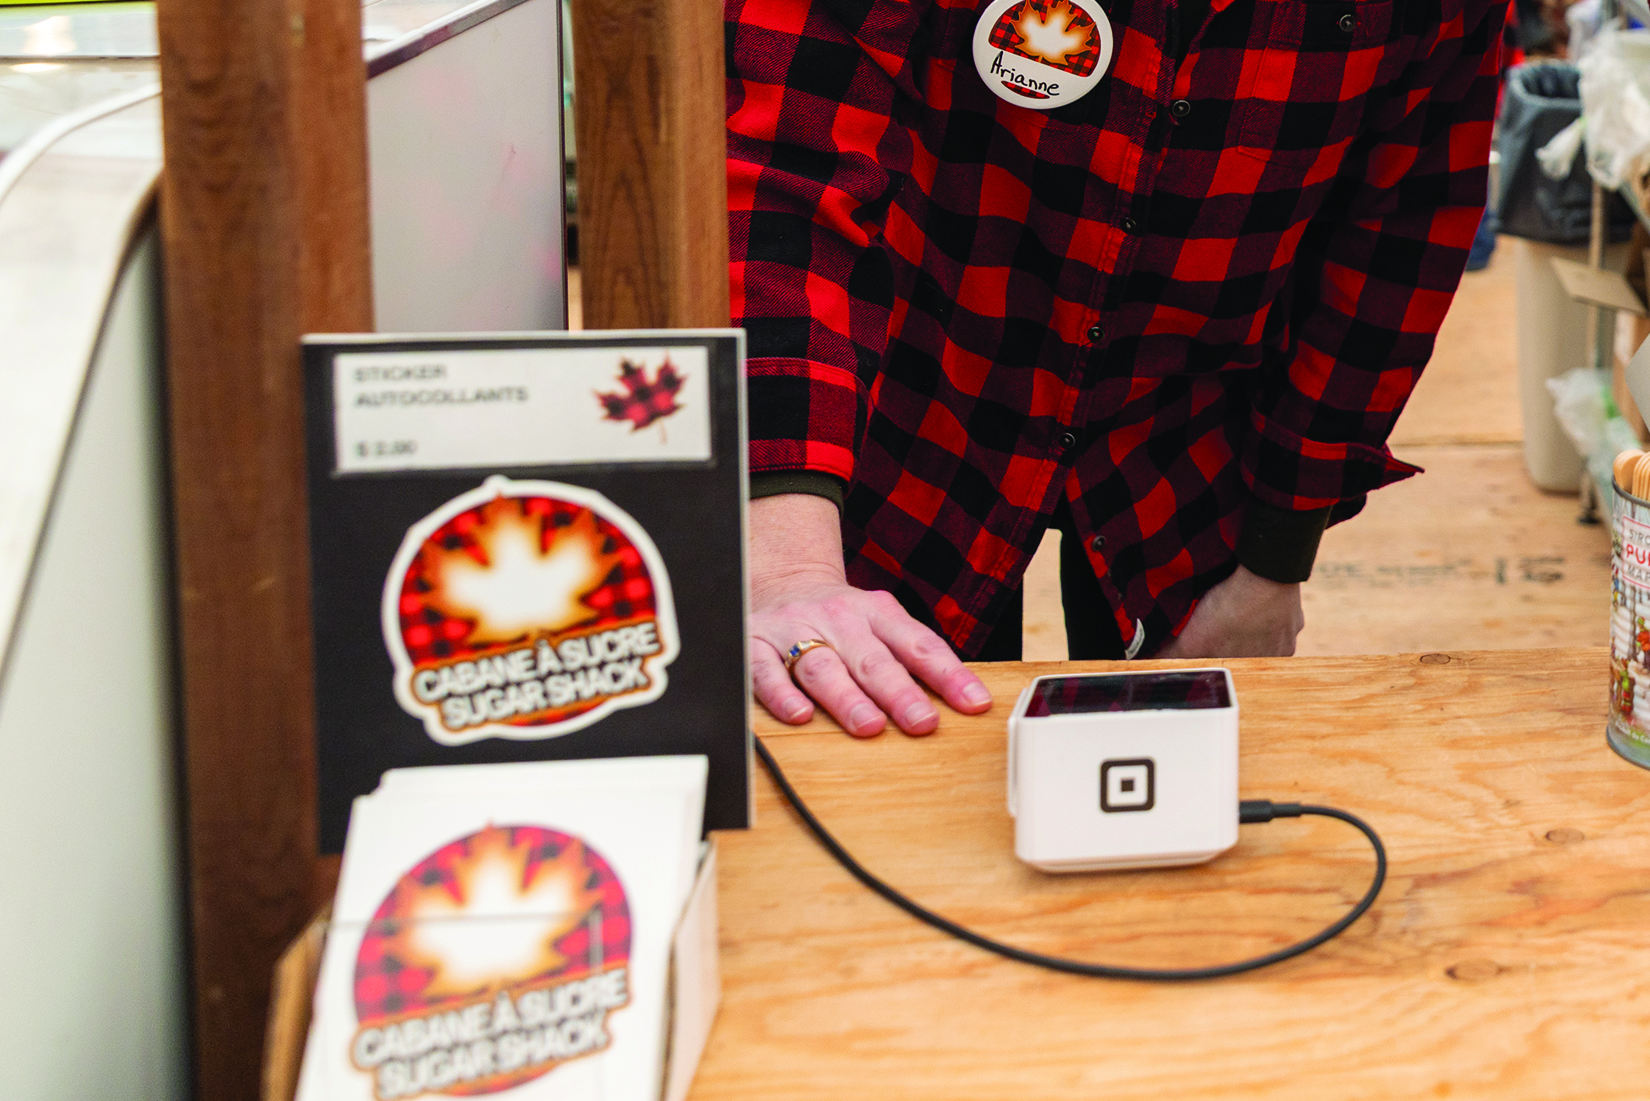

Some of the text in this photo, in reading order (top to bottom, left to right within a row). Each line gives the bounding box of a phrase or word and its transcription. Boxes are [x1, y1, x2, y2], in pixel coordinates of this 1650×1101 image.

[990, 51, 1060, 96] Arianne
[355, 366, 446, 382] STICKER
[355, 387, 528, 408] AUTOCOLLANTS
[415, 648, 536, 700] CABANE
[556, 622, 660, 667] SUCRE
[442, 657, 649, 728] SUGAR SHACK
[354, 1002, 492, 1069] CABANE
[518, 968, 627, 1029] SUCRE
[377, 1009, 608, 1100] SUGAR SHACK
